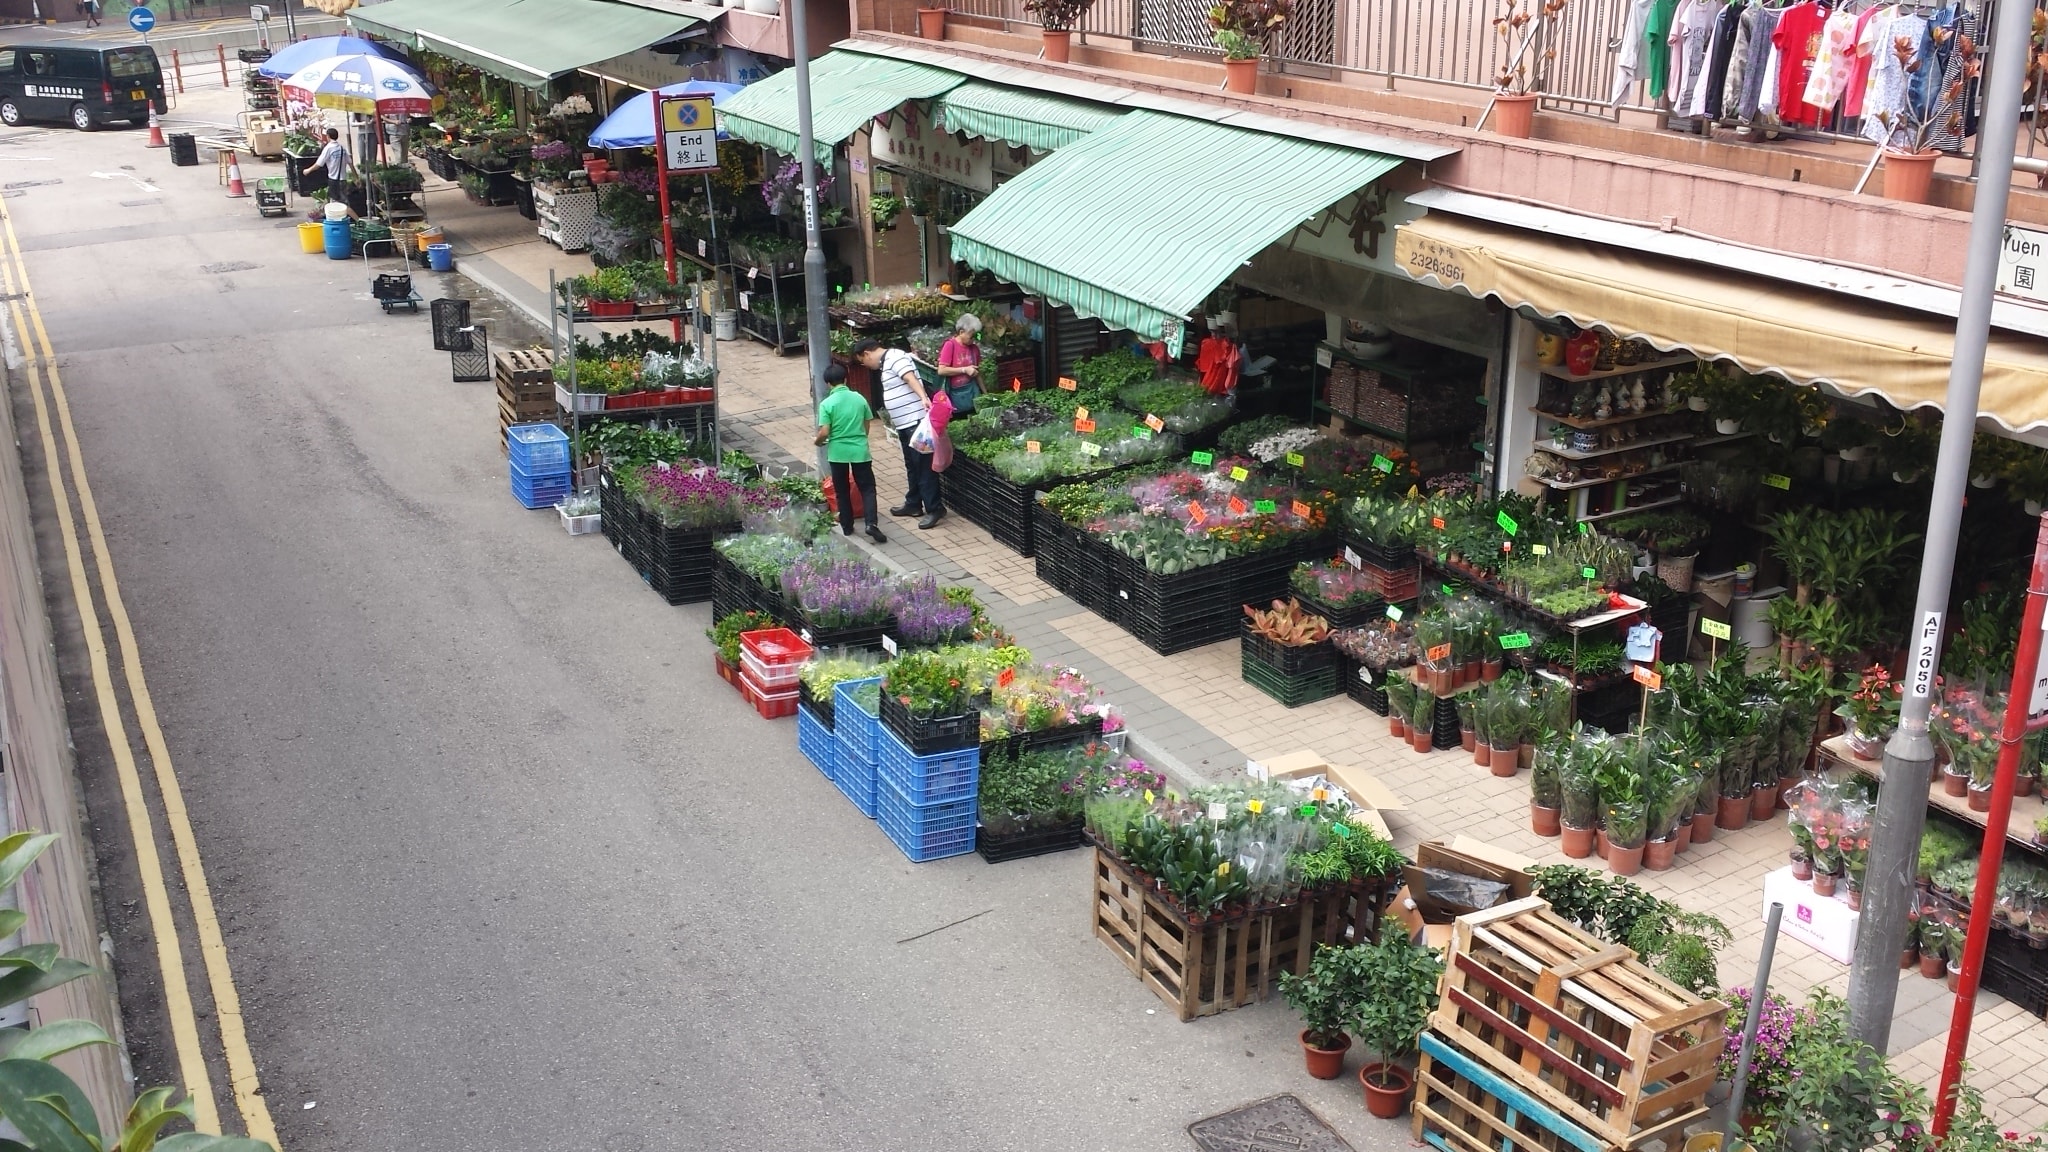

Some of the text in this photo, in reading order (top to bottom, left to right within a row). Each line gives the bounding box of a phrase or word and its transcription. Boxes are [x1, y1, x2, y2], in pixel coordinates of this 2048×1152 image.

[680, 134, 702, 146] End
[677, 149, 708, 164] 終止
[2003, 233, 2040, 256] Yuen
[1410, 251, 1465, 282] 23263961
[2014, 265, 2035, 290] 園
[1916, 646, 1932, 693] 2056
